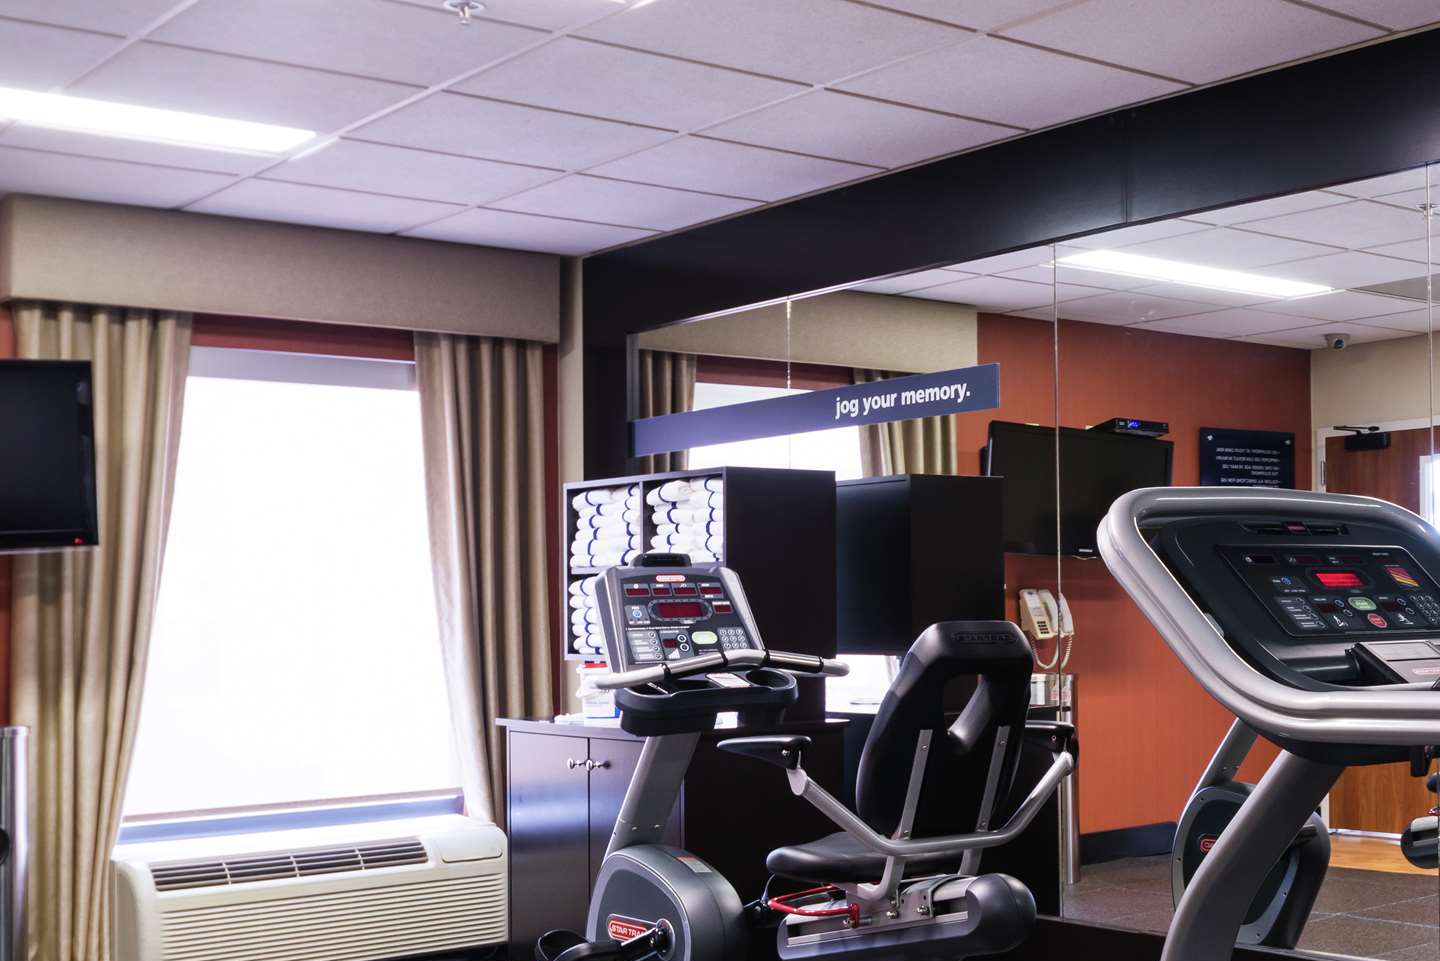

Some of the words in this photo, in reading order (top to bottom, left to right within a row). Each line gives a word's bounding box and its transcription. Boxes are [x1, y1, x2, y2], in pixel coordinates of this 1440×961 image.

[835, 397, 858, 419] jog
[863, 393, 897, 415] your
[901, 383, 971, 403] memory.
[611, 925, 627, 935] STAR
